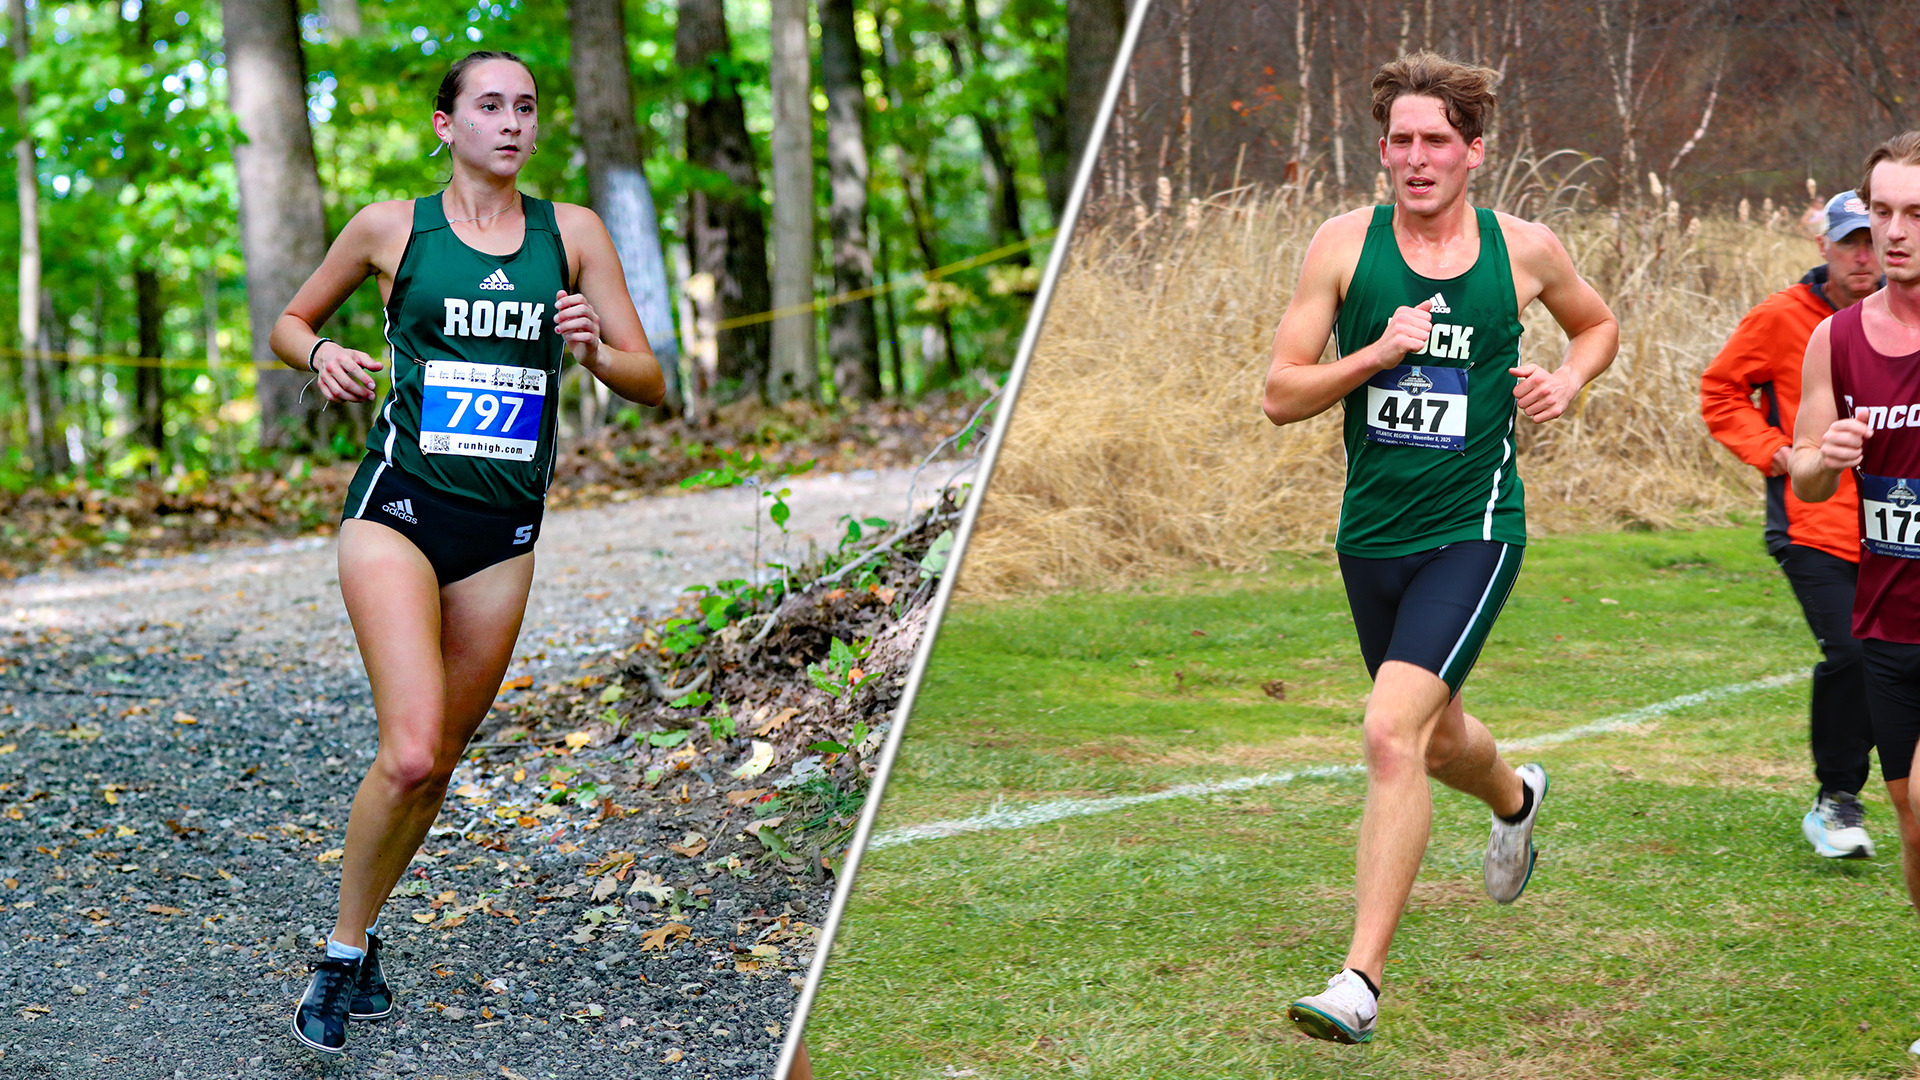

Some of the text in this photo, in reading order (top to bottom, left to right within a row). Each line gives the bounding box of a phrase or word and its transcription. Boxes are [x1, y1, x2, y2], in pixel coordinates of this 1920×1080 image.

[479, 281, 515, 291] adidas
[443, 297, 545, 341] ROCK
[1388, 317, 1474, 360] CK
[446, 391, 524, 433] 797
[1378, 396, 1449, 433] 447
[458, 441, 523, 455] runhigh.com
[381, 503, 418, 525] adidas
[512, 523, 534, 546] S
